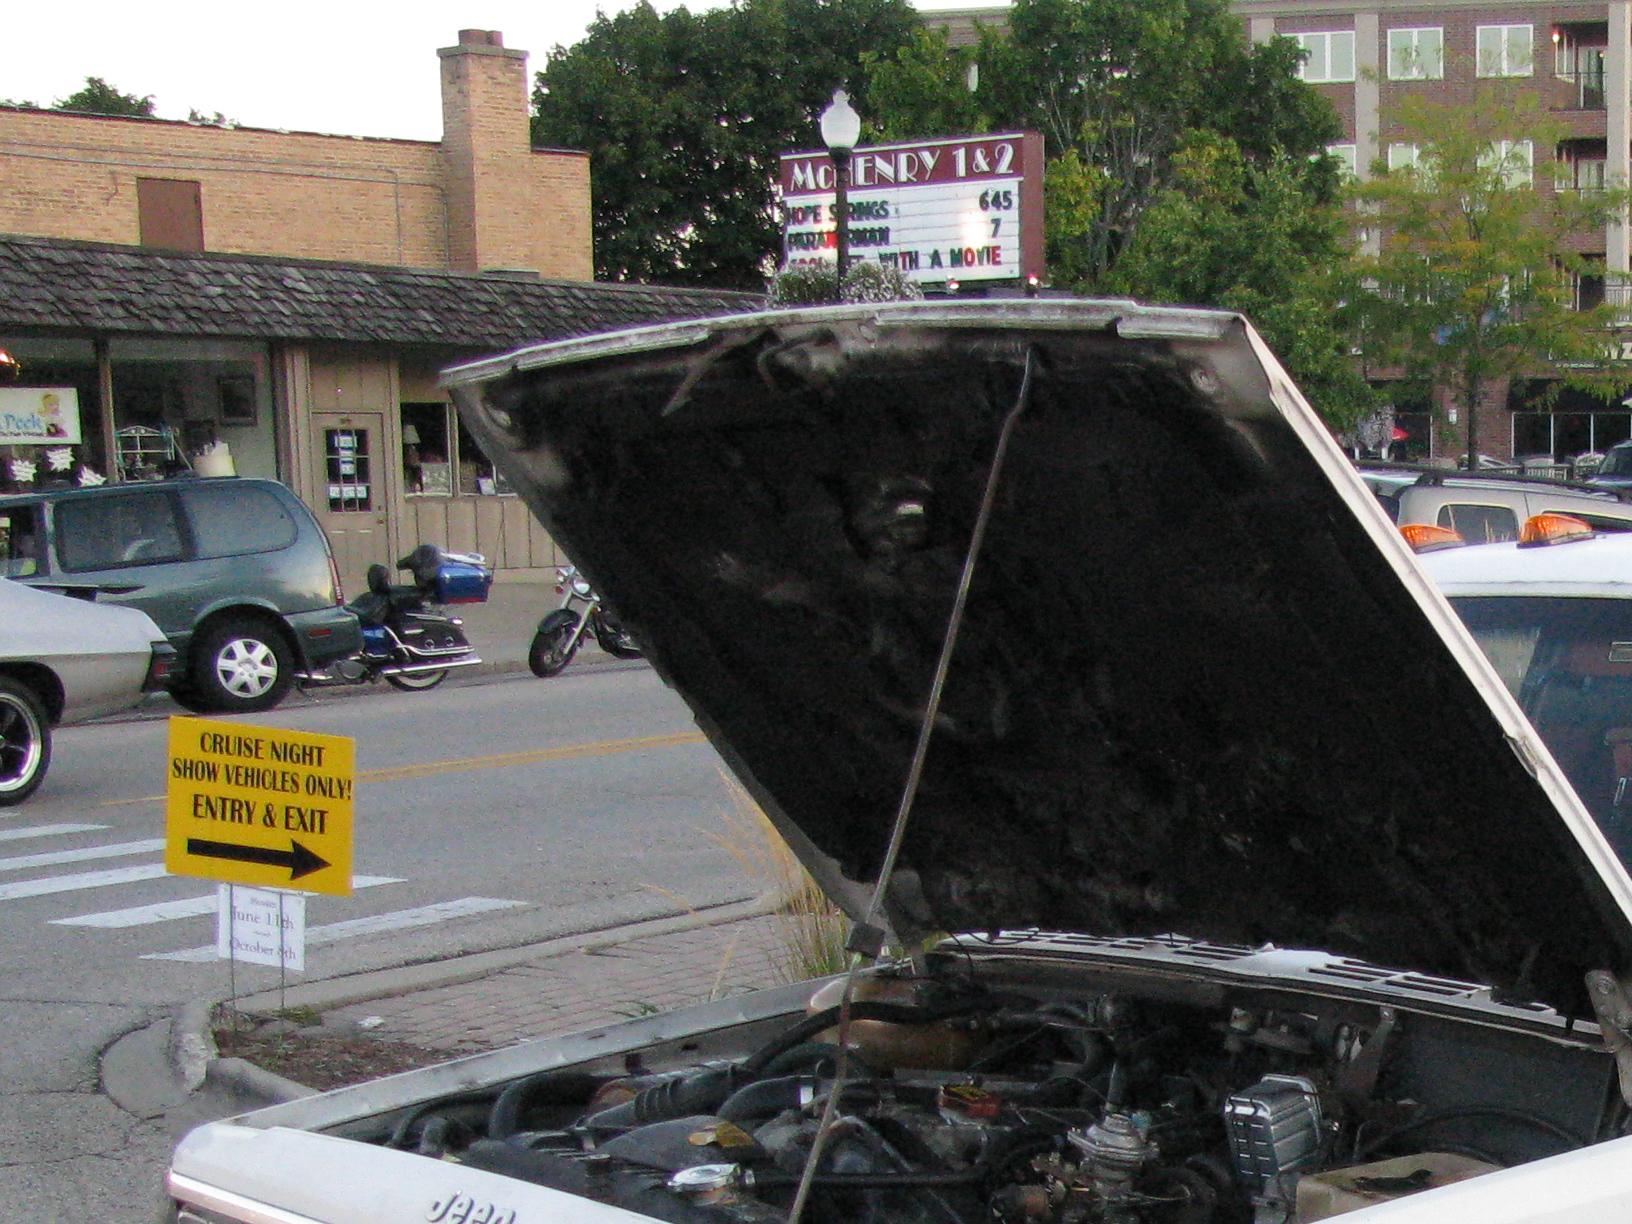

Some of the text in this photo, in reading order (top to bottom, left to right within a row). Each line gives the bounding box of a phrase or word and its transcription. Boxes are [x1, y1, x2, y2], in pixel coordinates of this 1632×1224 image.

[828, 200, 889, 222] SRINGS
[979, 190, 1013, 211] 645
[991, 217, 1001, 238] 7
[930, 248, 943, 269] A
[950, 245, 1002, 268] MOVIE
[200, 732, 326, 768] CRUISE NIGHT
[172, 757, 353, 801] SHOW VEHICLES ONLY!
[193, 793, 329, 835] ENTRY & EXIT
